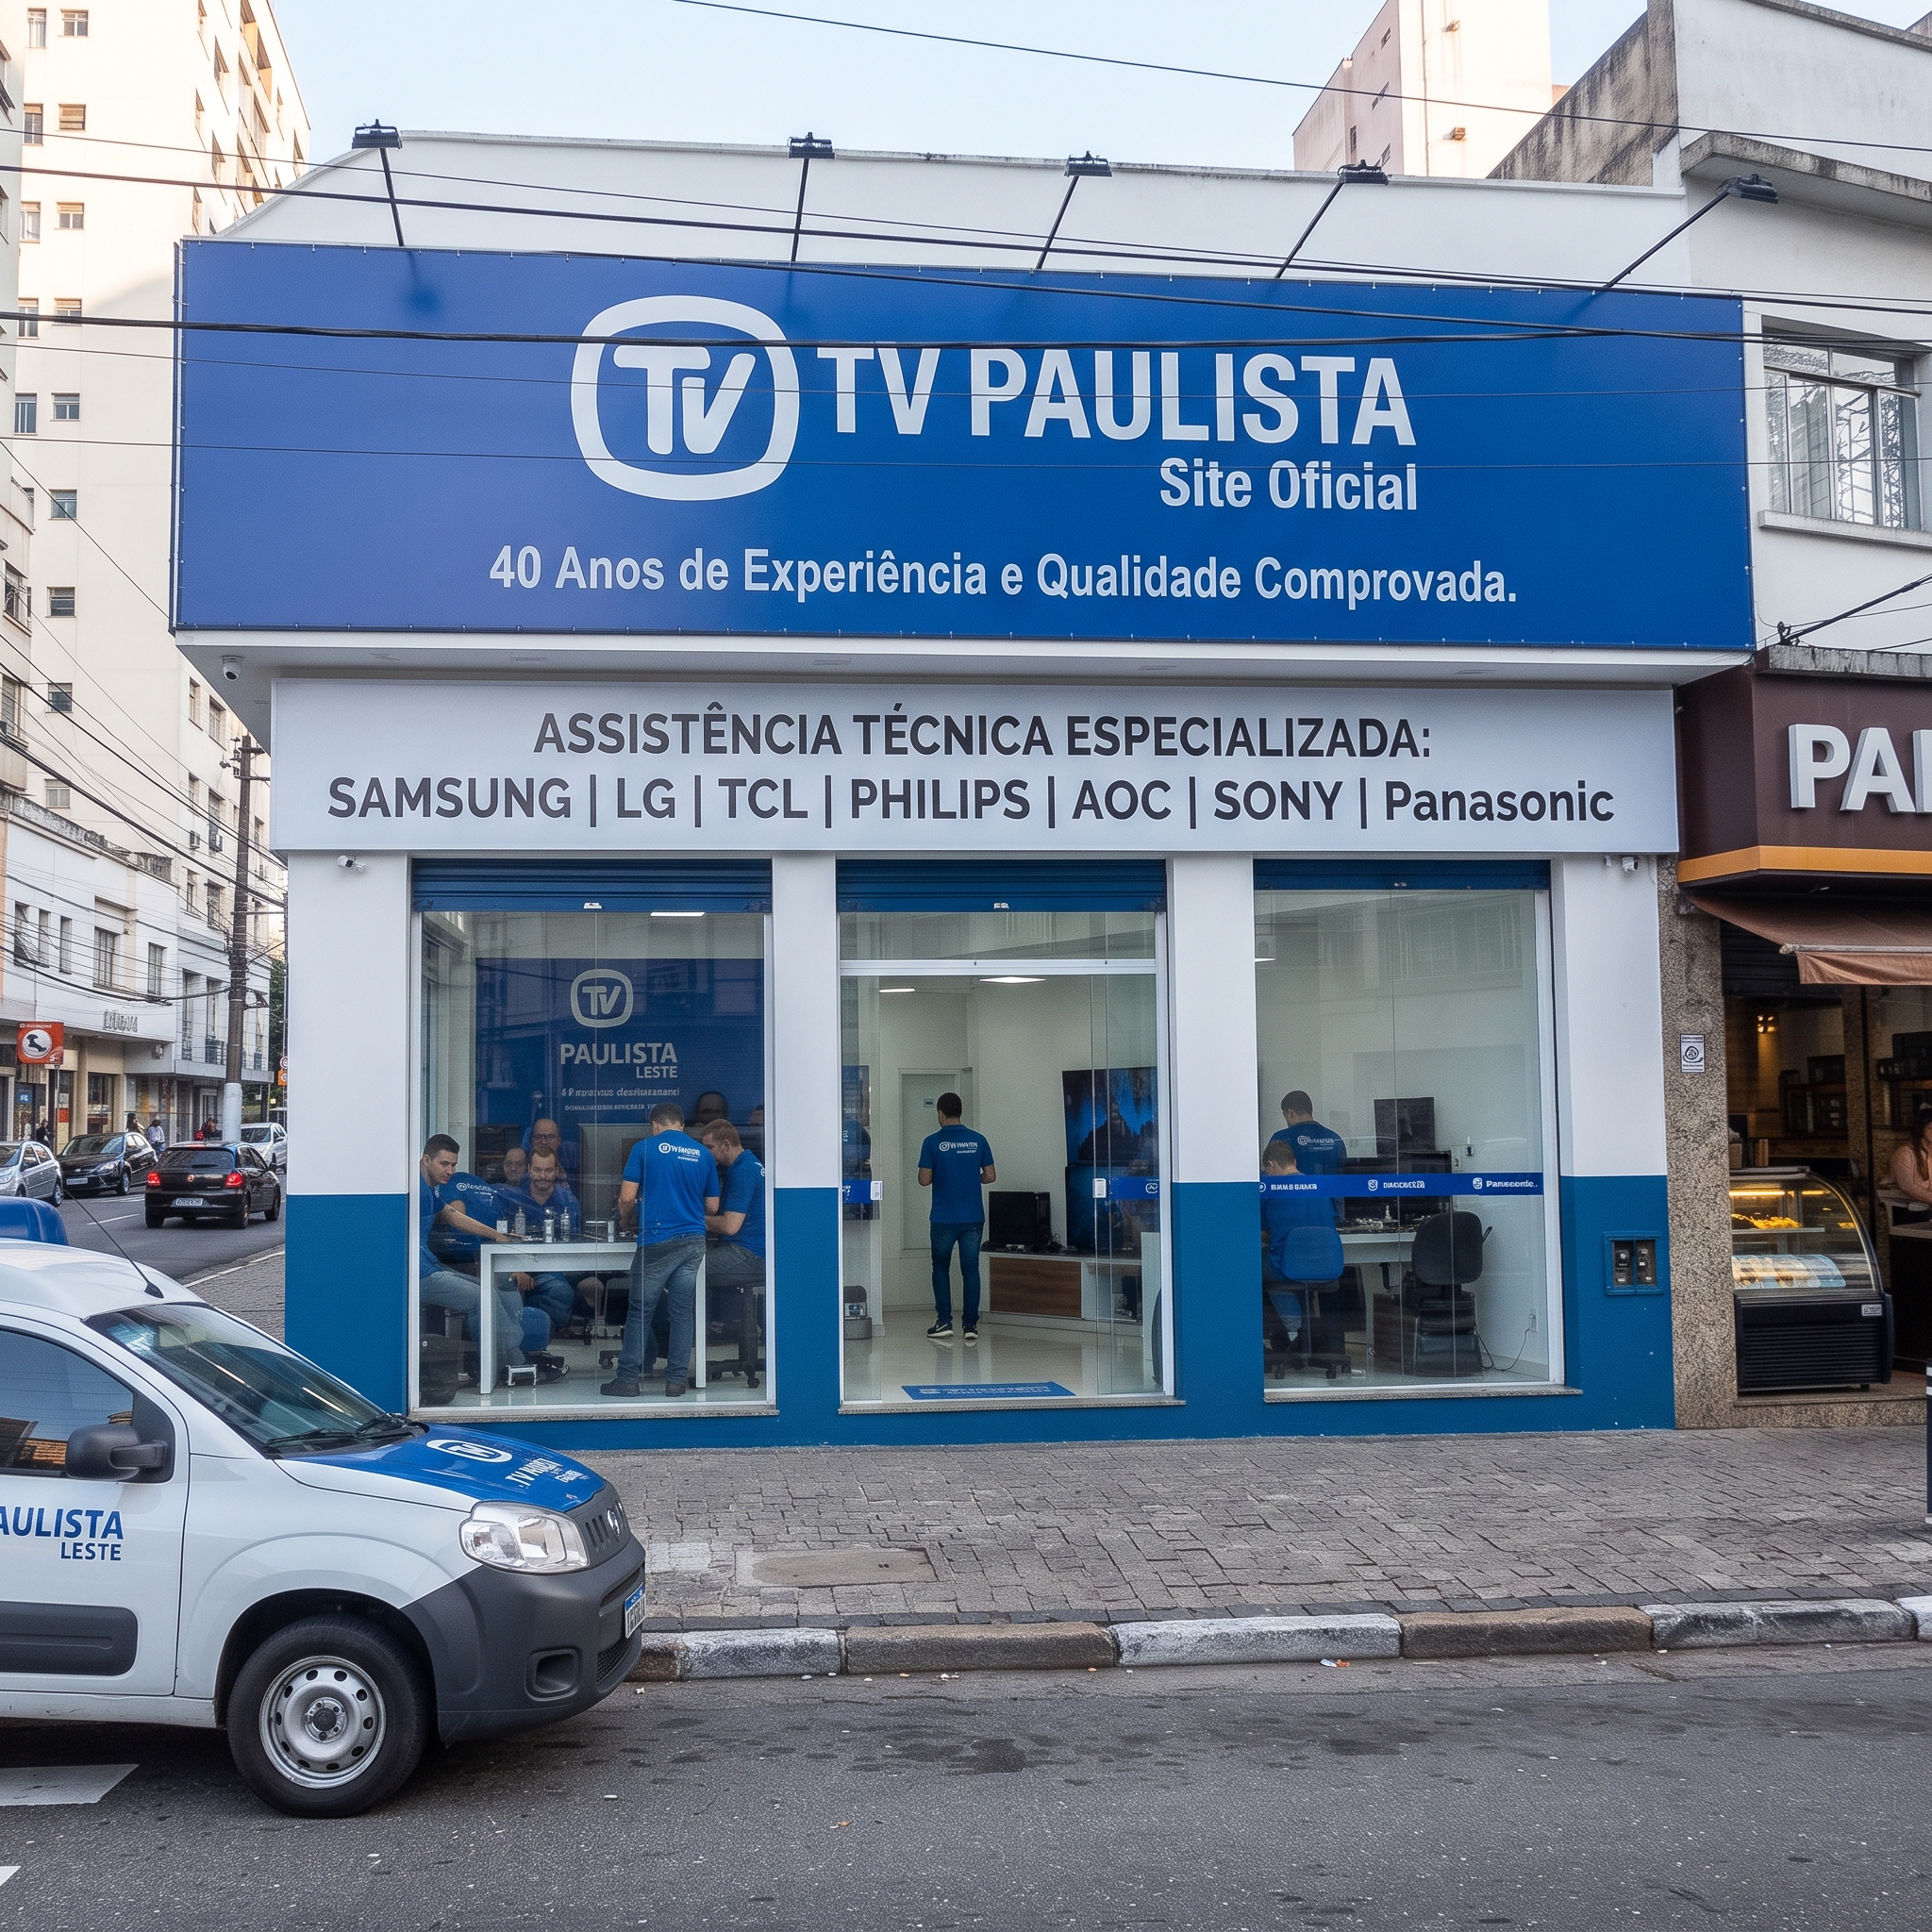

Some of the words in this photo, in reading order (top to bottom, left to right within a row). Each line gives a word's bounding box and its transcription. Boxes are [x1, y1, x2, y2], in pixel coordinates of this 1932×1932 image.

[613, 345, 757, 456] TV
[816, 346, 941, 435] TV
[970, 348, 1417, 446] PAULISTA
[1160, 458, 1252, 508] Site
[1269, 459, 1418, 510] Oficial
[490, 544, 541, 589] 40
[555, 546, 665, 591] Anos
[679, 547, 729, 591] de
[744, 548, 987, 603] Experiência
[1001, 563, 1024, 595] e
[1037, 553, 1241, 599] Qualidade
[1255, 557, 1516, 610] Comprovada.
[533, 701, 843, 755] ASSISTÊNCIA
[852, 702, 1054, 756] TÉCNICA
[1067, 715, 1430, 758] ESPECIALIZADA:
[327, 776, 571, 819] SAMSUNG
[617, 777, 675, 819] LG
[718, 778, 808, 819] TCL
[851, 778, 1030, 820] PHILIPS
[1072, 779, 1172, 821] AOC
[1213, 780, 1343, 821] SONY
[1385, 779, 1615, 822] Panasonic
[582, 985, 622, 1016] TV
[560, 1042, 678, 1065] PAULISTA
[636, 1066, 678, 1079] LESTE
[60, 1541, 122, 1561] LESTE
